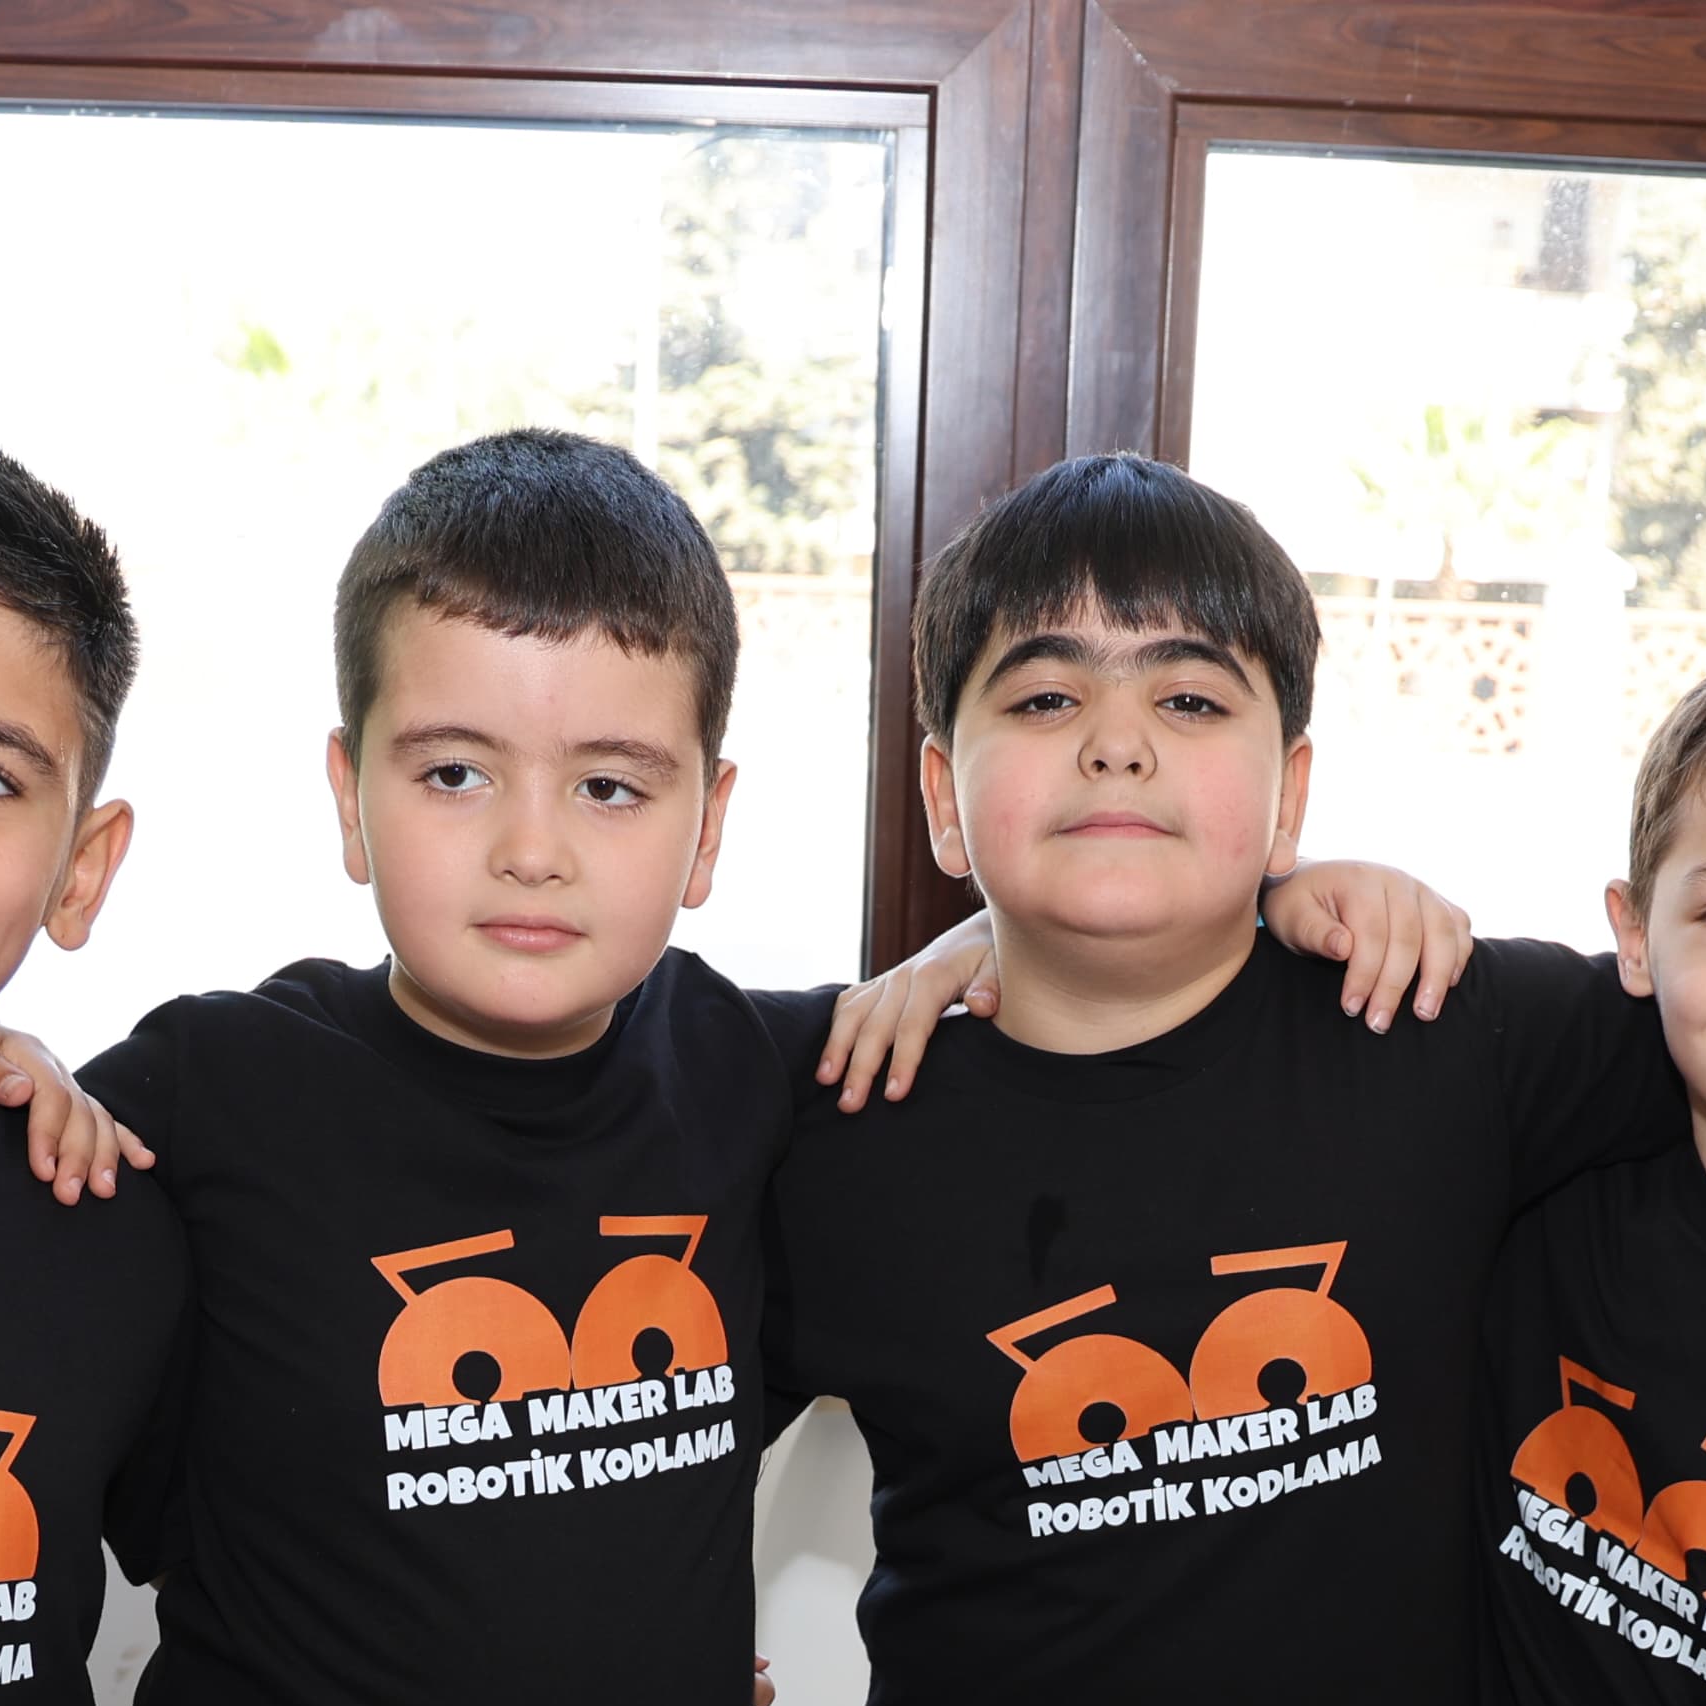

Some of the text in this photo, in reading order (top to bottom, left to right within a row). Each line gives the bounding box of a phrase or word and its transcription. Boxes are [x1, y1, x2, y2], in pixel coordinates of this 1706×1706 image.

[384, 1365, 735, 1451] MEGA MAKER LAB
[1022, 1384, 1378, 1488] MEGA MAKER LAB
[386, 1419, 735, 1510] ROBOTİK KODLAMA
[1027, 1434, 1382, 1537] ROBOTİK KODLAMA
[1499, 1524, 1618, 1627] ROBOTİK
[1596, 1536, 1699, 1625] MAKER
